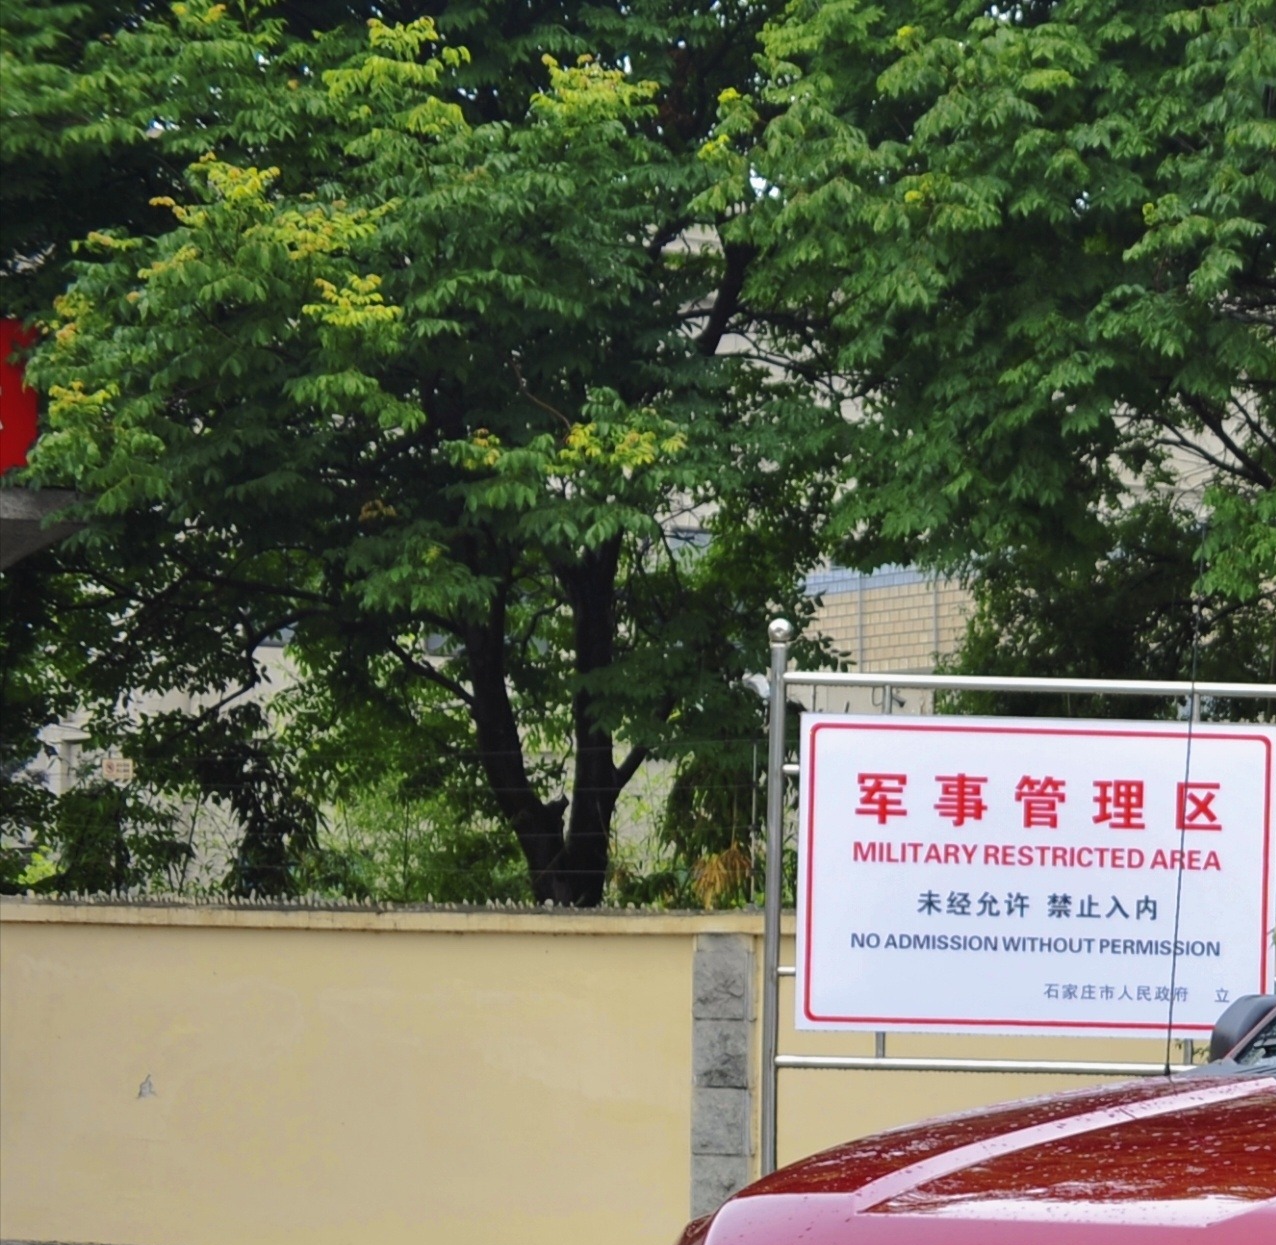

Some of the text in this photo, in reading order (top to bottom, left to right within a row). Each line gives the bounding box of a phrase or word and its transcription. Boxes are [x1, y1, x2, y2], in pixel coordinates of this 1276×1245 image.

[855, 773, 1222, 831] 军事管理区
[853, 842, 1222, 871] MILITARY RESTRICTED AREA
[917, 890, 1159, 921] 未经允许 禁止入内
[850, 932, 1221, 958] NO ADMISSION WITHOUT PERMISSION
[1043, 984, 1230, 1003] 石家庄市人民政府 立
